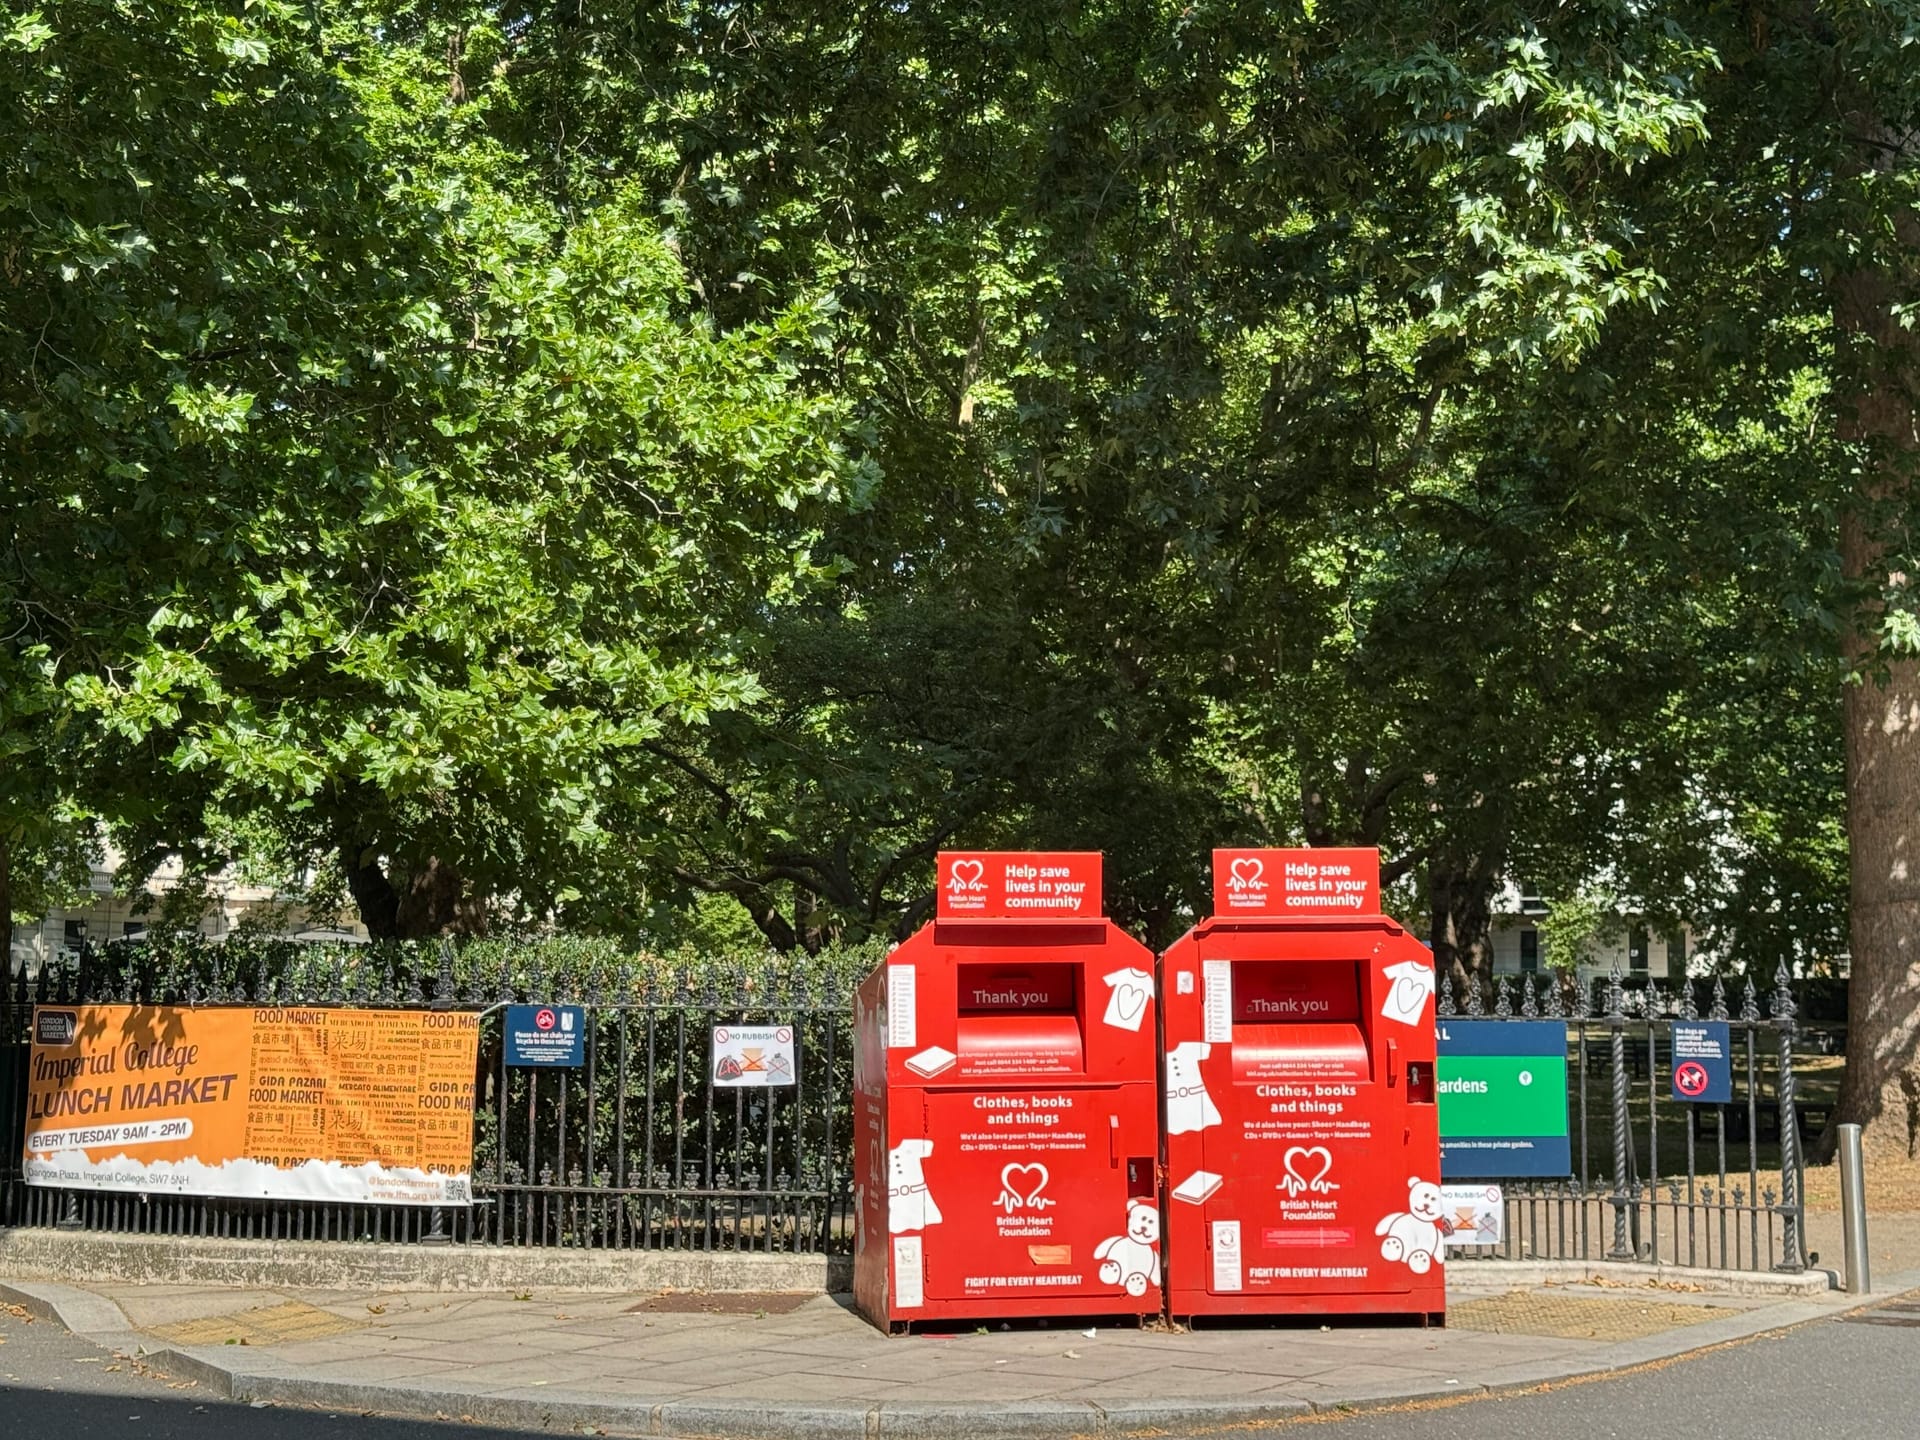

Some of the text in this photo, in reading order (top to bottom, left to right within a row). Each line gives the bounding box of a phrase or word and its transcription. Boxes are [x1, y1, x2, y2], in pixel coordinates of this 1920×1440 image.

[1005, 864, 1070, 880] Help save
[1285, 863, 1350, 878] Help save
[1005, 880, 1085, 895] lives in your
[1285, 878, 1367, 894] lives in your
[1005, 895, 1082, 911] community
[1286, 893, 1363, 909] community
[973, 989, 1048, 1007] Thank you
[1252, 998, 1328, 1014] Thank you
[254, 1010, 328, 1025] FOOD MARKET
[422, 1014, 454, 1029] FOOD
[331, 1030, 367, 1051] 菜場
[421, 1038, 462, 1050] 食品市場
[34, 1040, 198, 1088] Imperial College
[376, 1063, 417, 1075] 食品市場
[259, 1076, 285, 1087] GIDA
[289, 1077, 327, 1088] PAZARI
[339, 1083, 416, 1093] MERCATO ALIMENTARE
[429, 1082, 458, 1093] GIDA
[31, 1074, 237, 1120] LUNCH MARKET
[249, 1088, 324, 1104] FOOD MARKET
[1256, 1084, 1356, 1097] Clothes, books
[419, 1095, 474, 1111] FOOD MA
[974, 1096, 1073, 1109] Clothes, books
[1270, 1100, 1343, 1115] and things
[417, 1118, 458, 1131] 食品市場
[988, 1112, 1059, 1126] and things
[1293, 1122, 1311, 1130] your:
[32, 1133, 65, 1148] EVERY
[68, 1128, 120, 1145] TUESDAY
[123, 1125, 149, 1140] 9AM
[160, 1122, 187, 1136] 2PM
[372, 1144, 413, 1156] 食品市場
[1493, 1142, 1510, 1150] private
[427, 1164, 455, 1174] GIDA
[59, 1170, 82, 1180] Plaza,
[83, 1172, 114, 1183] Imperial
[115, 1173, 147, 1184] College,
[150, 1174, 168, 1184] SW7
[171, 1175, 189, 1184] 5NH
[1280, 1200, 1338, 1210] British Heart
[996, 1217, 1053, 1226] British Heart
[1283, 1211, 1335, 1220] Foundation
[999, 1227, 1050, 1236] Foundation
[1250, 1267, 1368, 1277] FIGHT FOR EVERY HEARTBEAT
[965, 1275, 1082, 1287] FIGHT FOR EVERY HEARTBEAT
